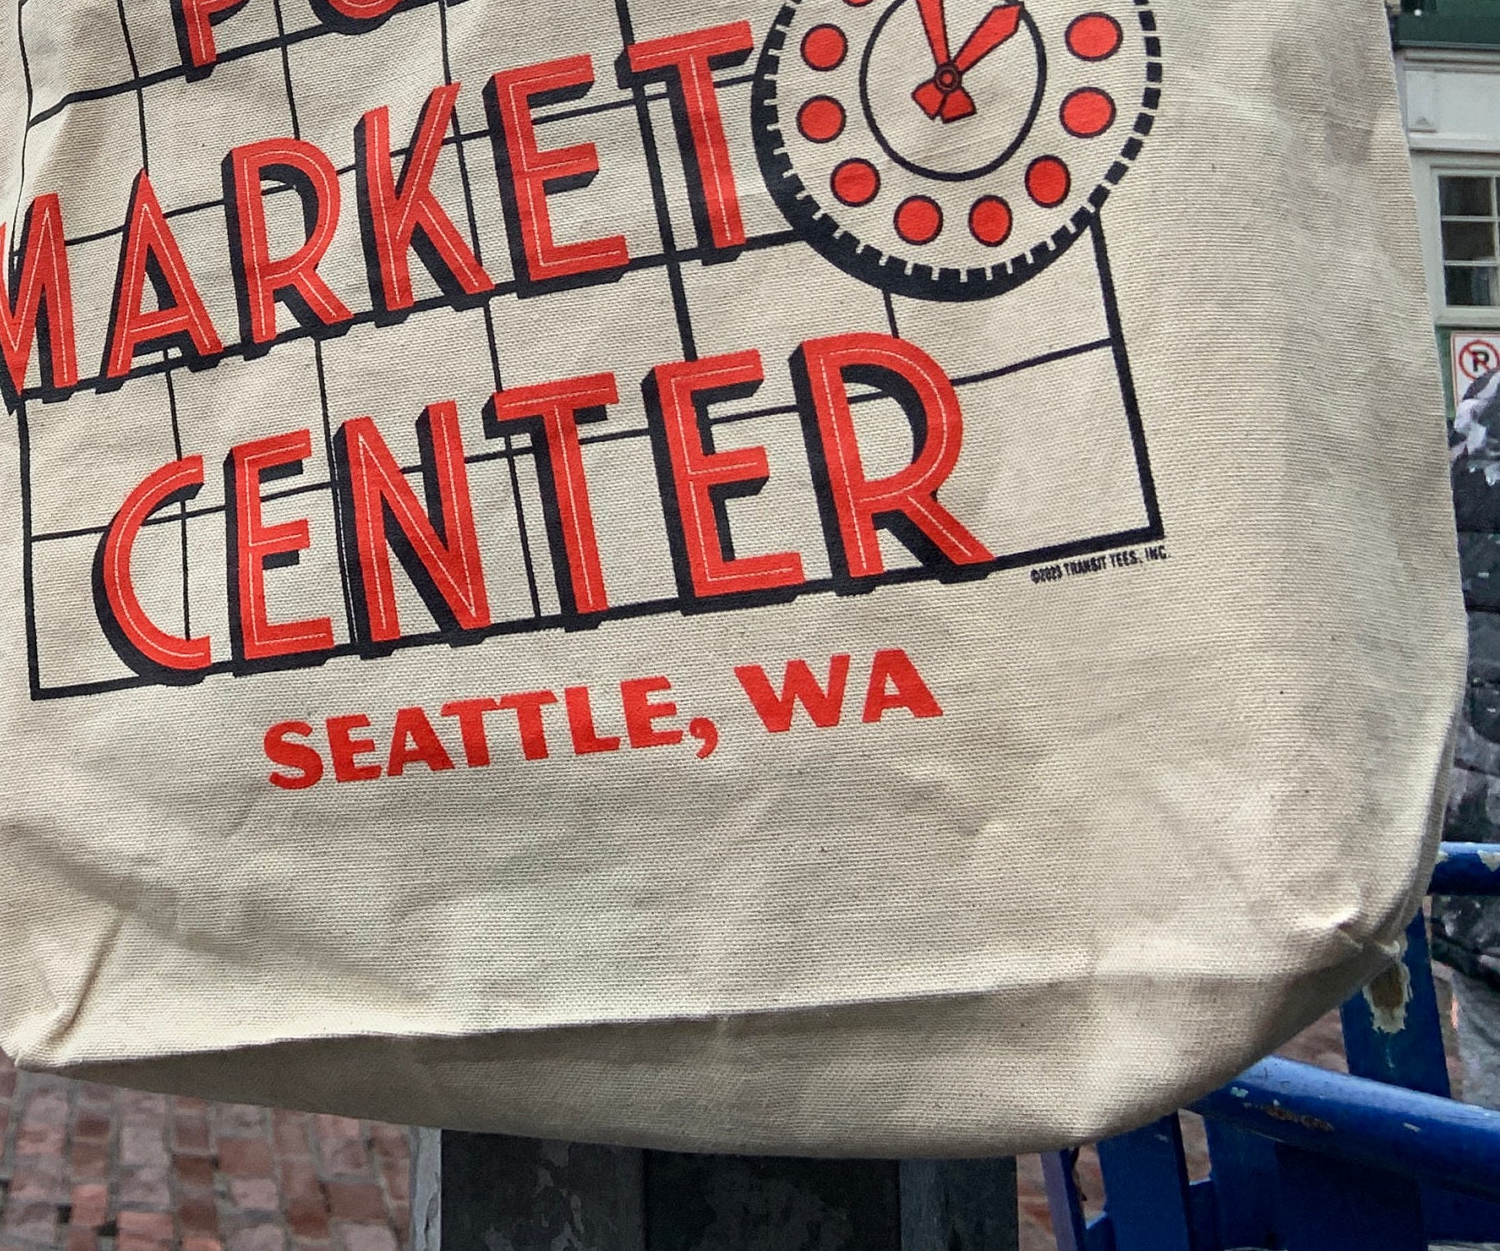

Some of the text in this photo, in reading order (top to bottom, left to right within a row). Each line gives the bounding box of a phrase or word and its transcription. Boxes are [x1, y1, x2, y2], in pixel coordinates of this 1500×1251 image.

[93, 332, 996, 683] CENTER
[1063, 555, 1108, 577] TRANSIT
[263, 648, 944, 790] SEATTLE, WA
